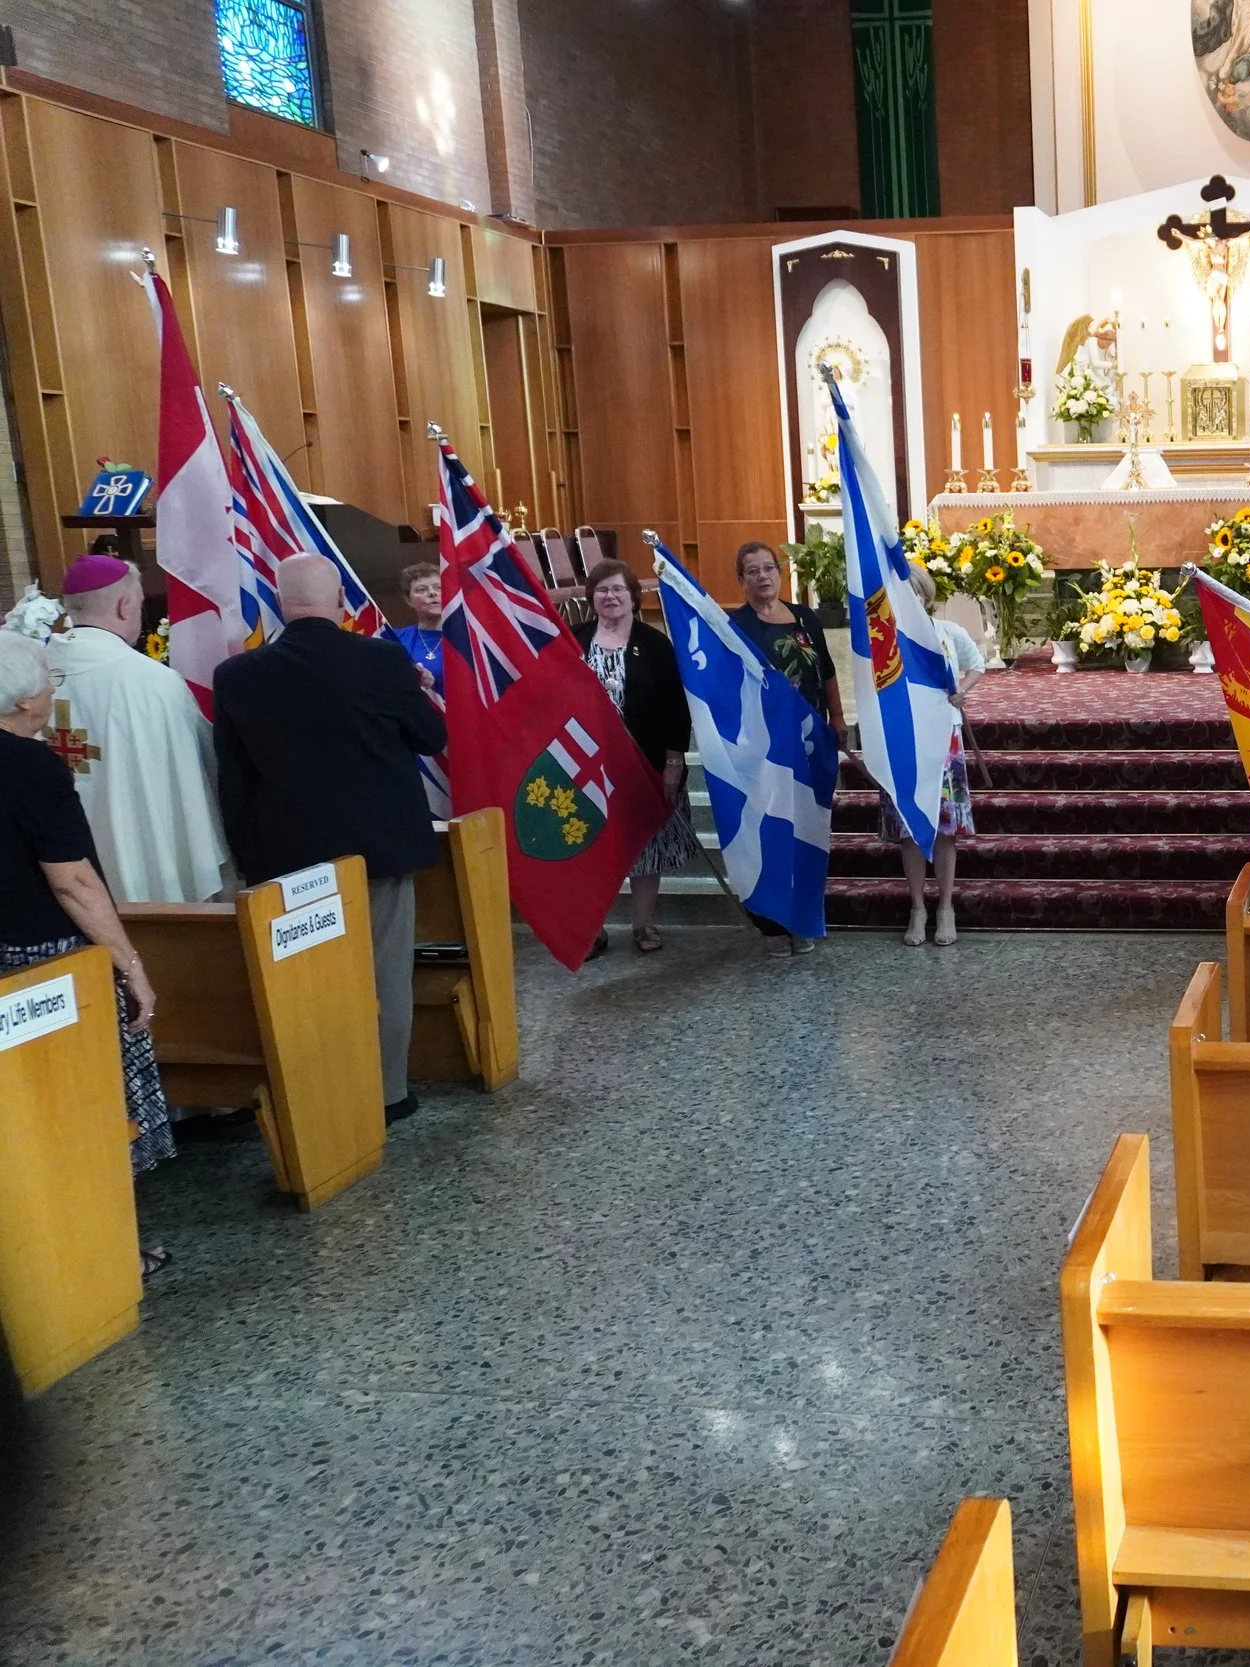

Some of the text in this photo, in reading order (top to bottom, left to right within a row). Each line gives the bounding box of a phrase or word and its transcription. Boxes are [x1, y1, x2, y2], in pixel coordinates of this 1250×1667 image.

[291, 875, 329, 896] RESERVED
[276, 909, 337, 949] Dignitaries & Guests
[9, 1002, 27, 1027] Life
[27, 992, 66, 1021] Members
